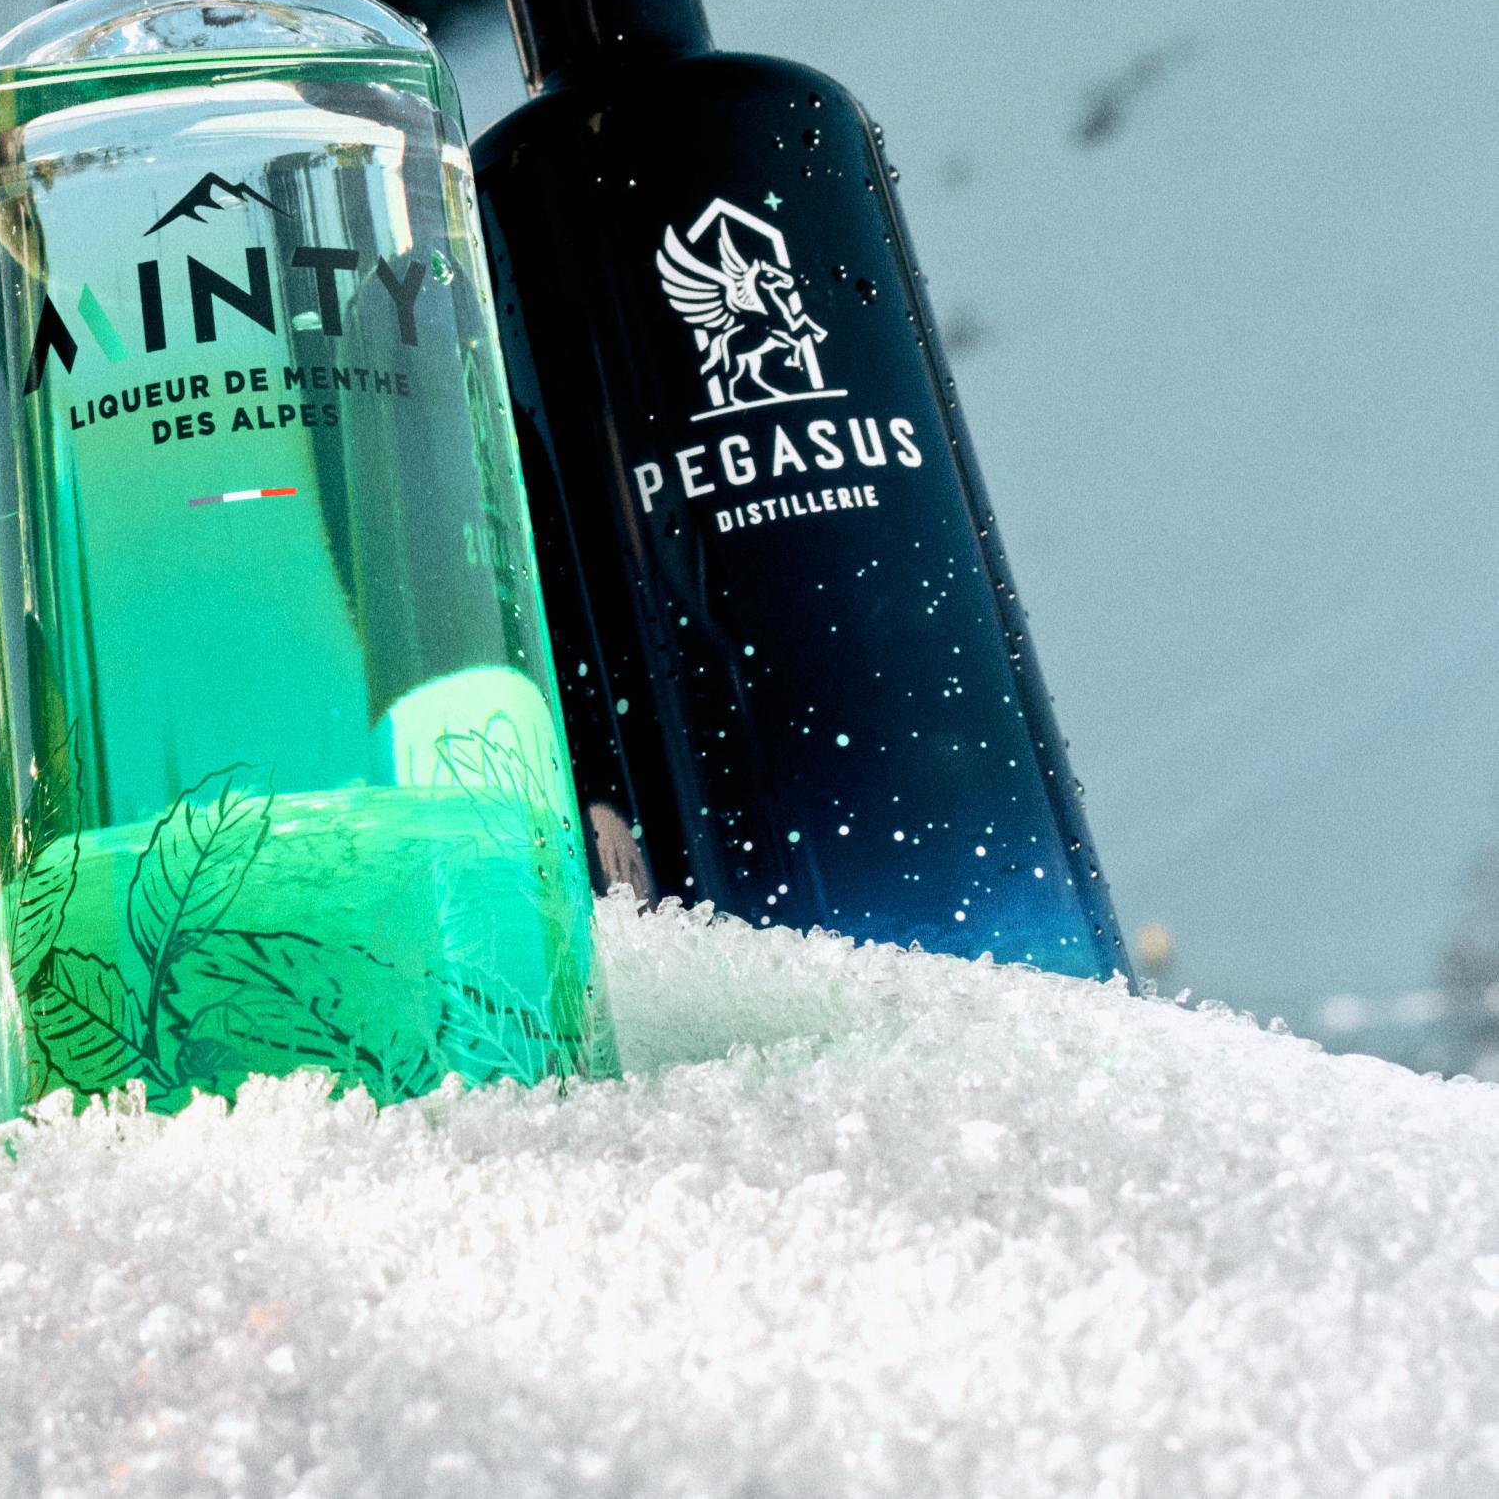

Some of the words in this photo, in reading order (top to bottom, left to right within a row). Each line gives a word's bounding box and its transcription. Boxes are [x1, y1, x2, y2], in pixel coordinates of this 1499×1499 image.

[23, 246, 426, 398] MINTY
[70, 374, 210, 431] LIQUEUR
[224, 368, 269, 394] DE
[285, 366, 411, 397] MENTHE
[152, 412, 216, 445] DES
[232, 403, 339, 433] ALPES
[633, 418, 923, 513] PEGASUS
[715, 485, 880, 533] DISTILLERIE
